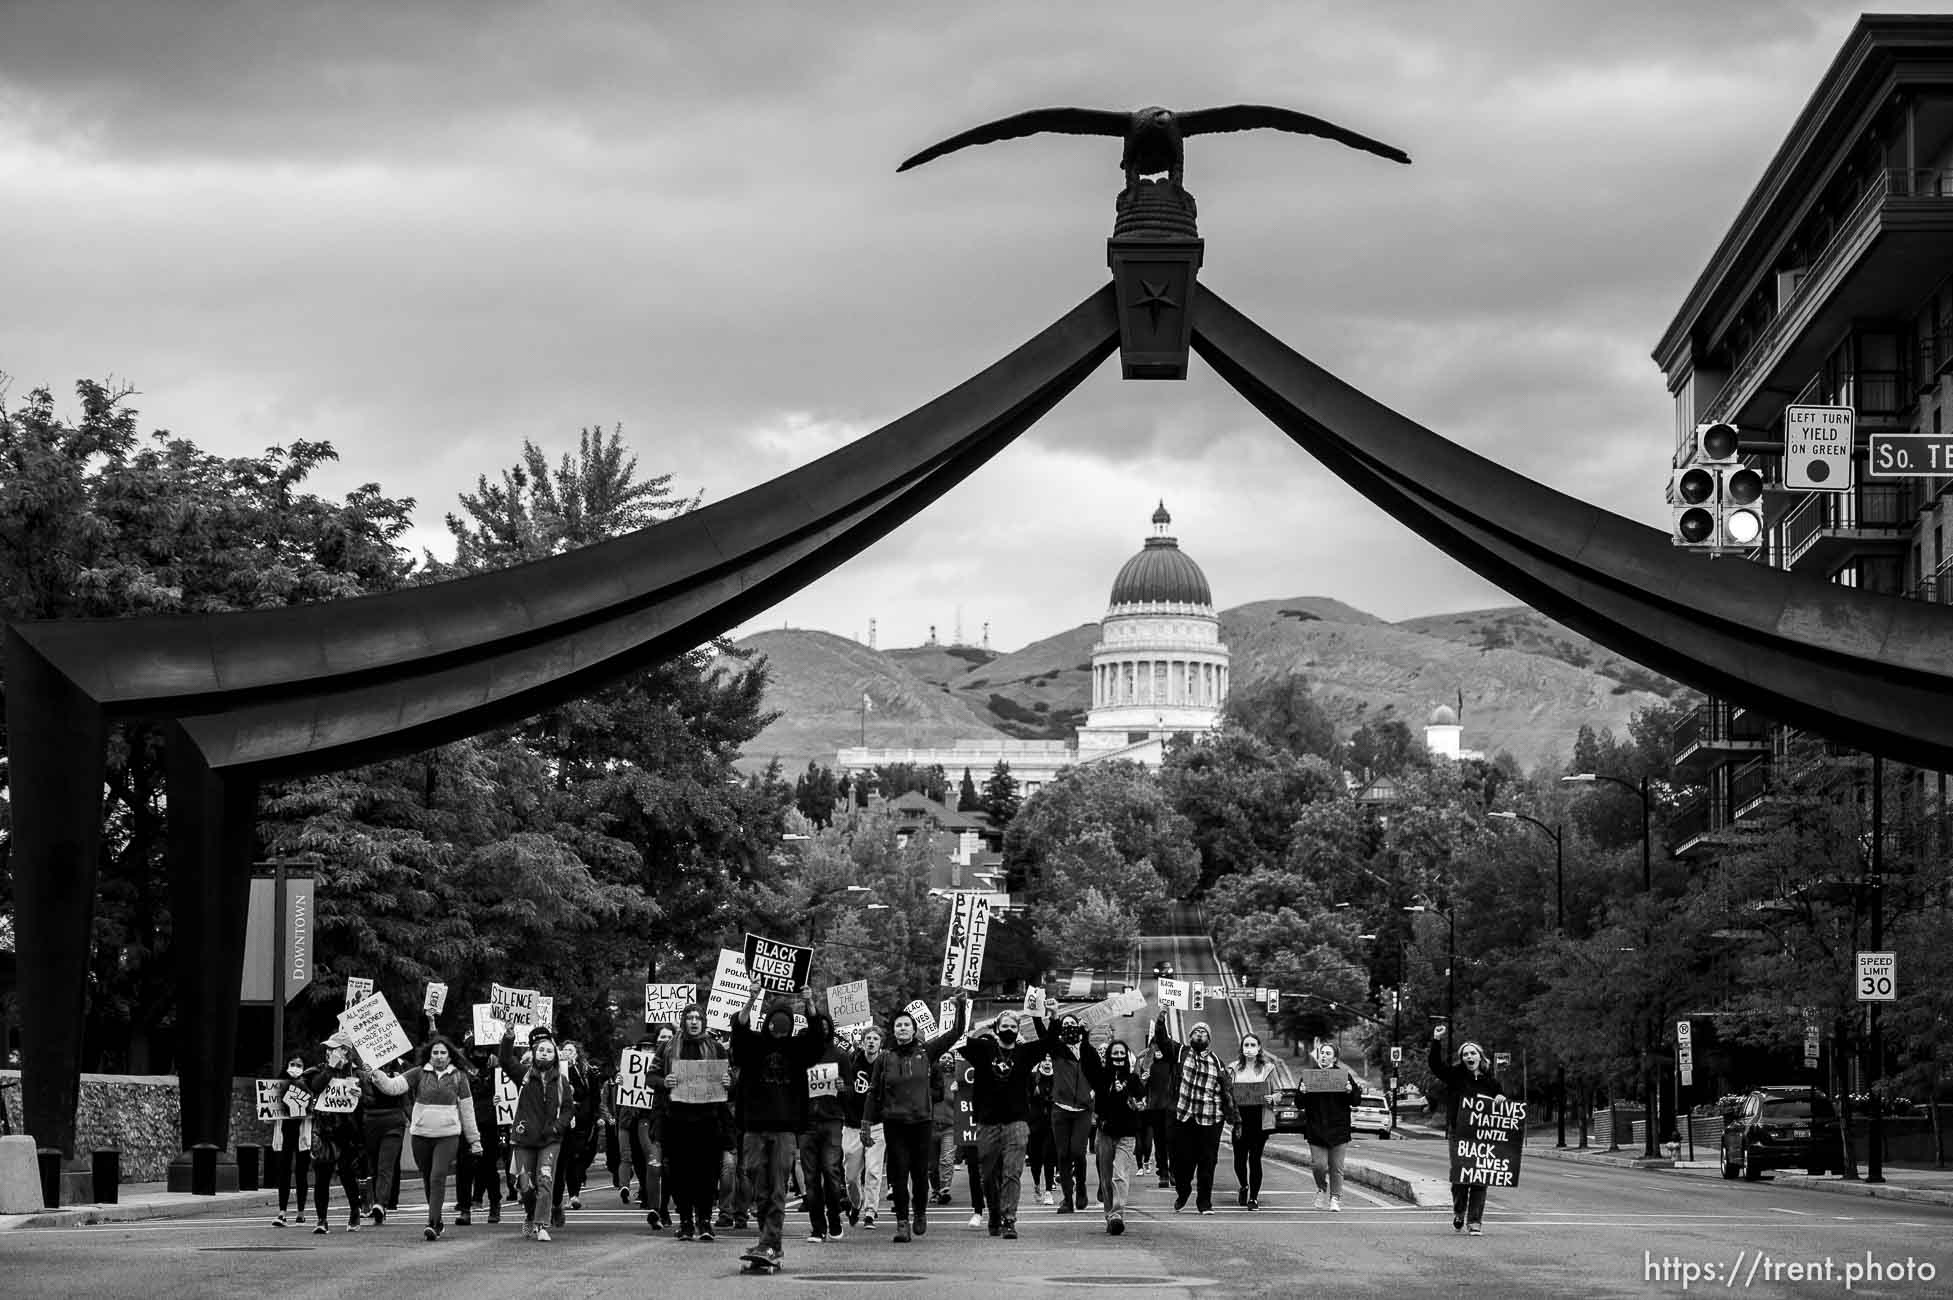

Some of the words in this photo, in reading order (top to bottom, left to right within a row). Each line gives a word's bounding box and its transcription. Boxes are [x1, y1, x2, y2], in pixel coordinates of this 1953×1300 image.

[1790, 413, 1816, 424] LEFT
[1822, 414, 1850, 425] TURN
[1802, 428, 1838, 441] YIELD
[1792, 444, 1806, 454] ON
[1812, 444, 1847, 456] GREEN
[1880, 443, 1914, 468] So.
[1927, 444, 1953, 468] TE
[293, 895, 306, 980] DOWNTOWN
[970, 898, 988, 970] MATTER
[756, 940, 798, 962] BLACK
[755, 957, 792, 976] LIVES
[1860, 957, 1893, 966] SPEED
[725, 968, 748, 979] POLIC
[1863, 967, 1889, 976] LIMIT
[647, 984, 695, 1004] BLACK
[720, 980, 751, 993] BRUTAL
[1862, 977, 1892, 995] 30
[492, 986, 533, 1010] SILENCE
[647, 1001, 683, 1011] LIVE
[710, 995, 722, 1003] NO
[839, 994, 853, 1004] THE
[833, 1000, 866, 1018] POLICE
[353, 1030, 379, 1048] GEORGE
[810, 1081, 831, 1091] OOT
[323, 1096, 353, 1109] SHOOT
[1462, 1097, 1485, 1112] NO
[1491, 1100, 1527, 1120] LIVES
[1470, 1112, 1519, 1131] MATTER
[1476, 1130, 1509, 1142] UNTIL
[1457, 1140, 1496, 1159] BLACK
[1475, 1157, 1510, 1171] LIVES
[1460, 1168, 1513, 1186] MATTER
